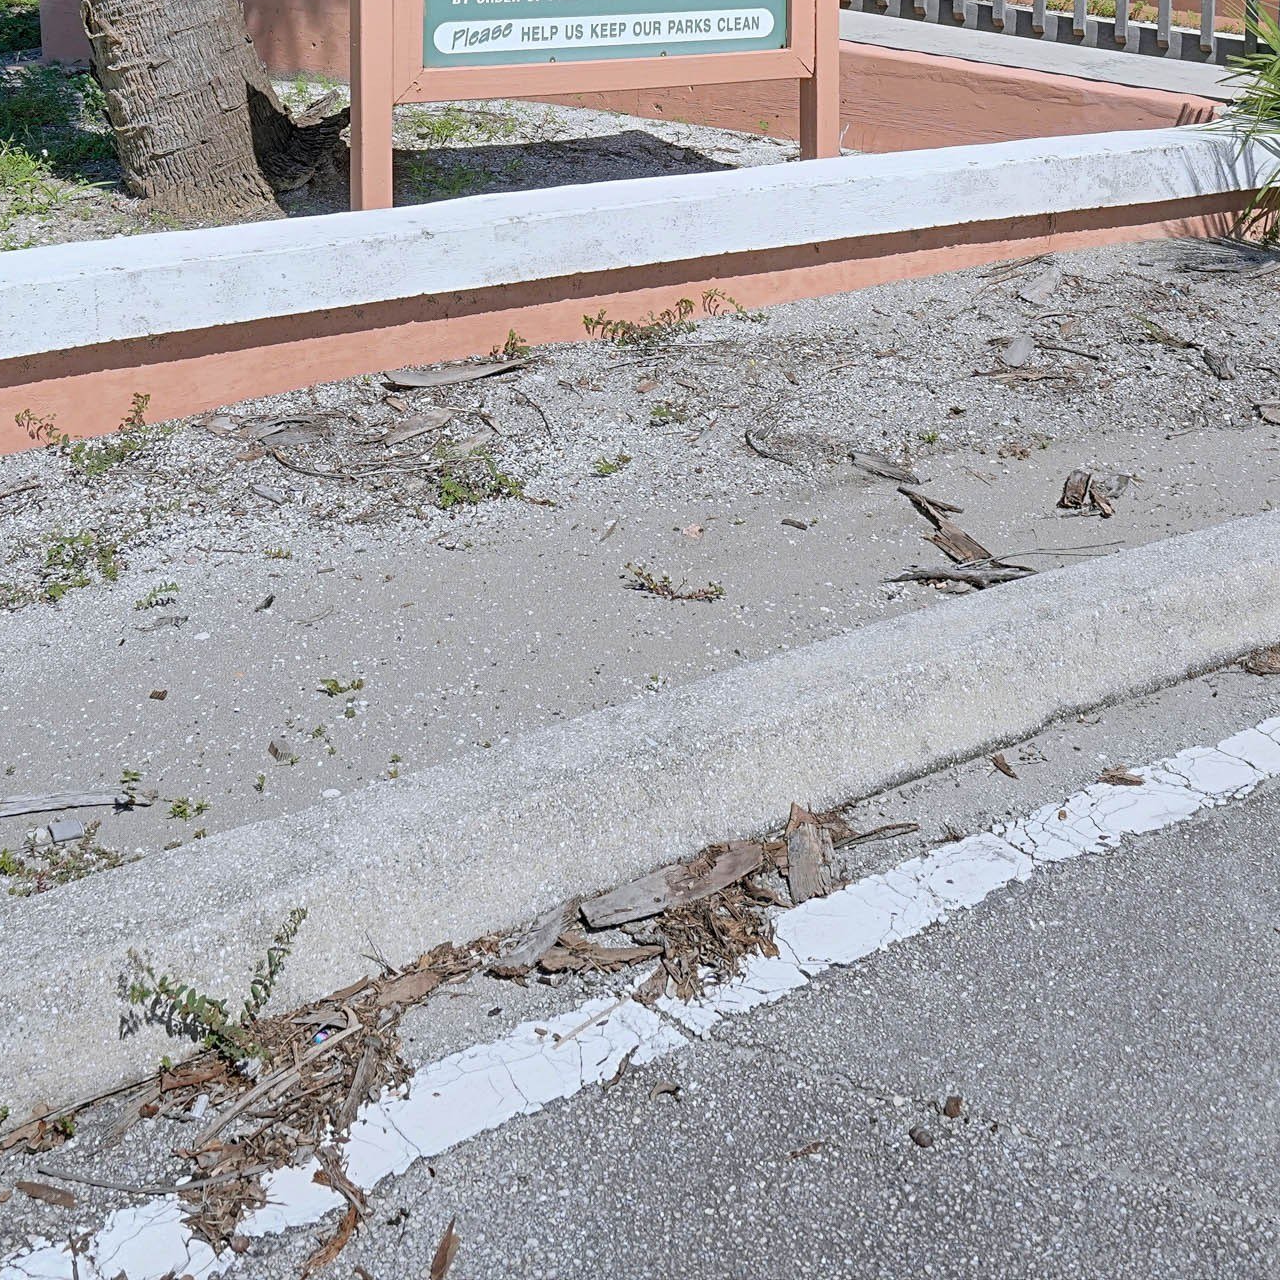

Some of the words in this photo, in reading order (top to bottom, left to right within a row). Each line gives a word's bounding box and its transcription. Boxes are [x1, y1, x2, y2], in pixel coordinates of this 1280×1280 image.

[452, 22, 512, 49] Please
[522, 25, 558, 42] HELP
[565, 24, 583, 39] US
[590, 22, 626, 39] KEEP
[633, 20, 661, 37] OUR
[668, 19, 711, 35] PARKS
[718, 16, 759, 32] CLEAN
